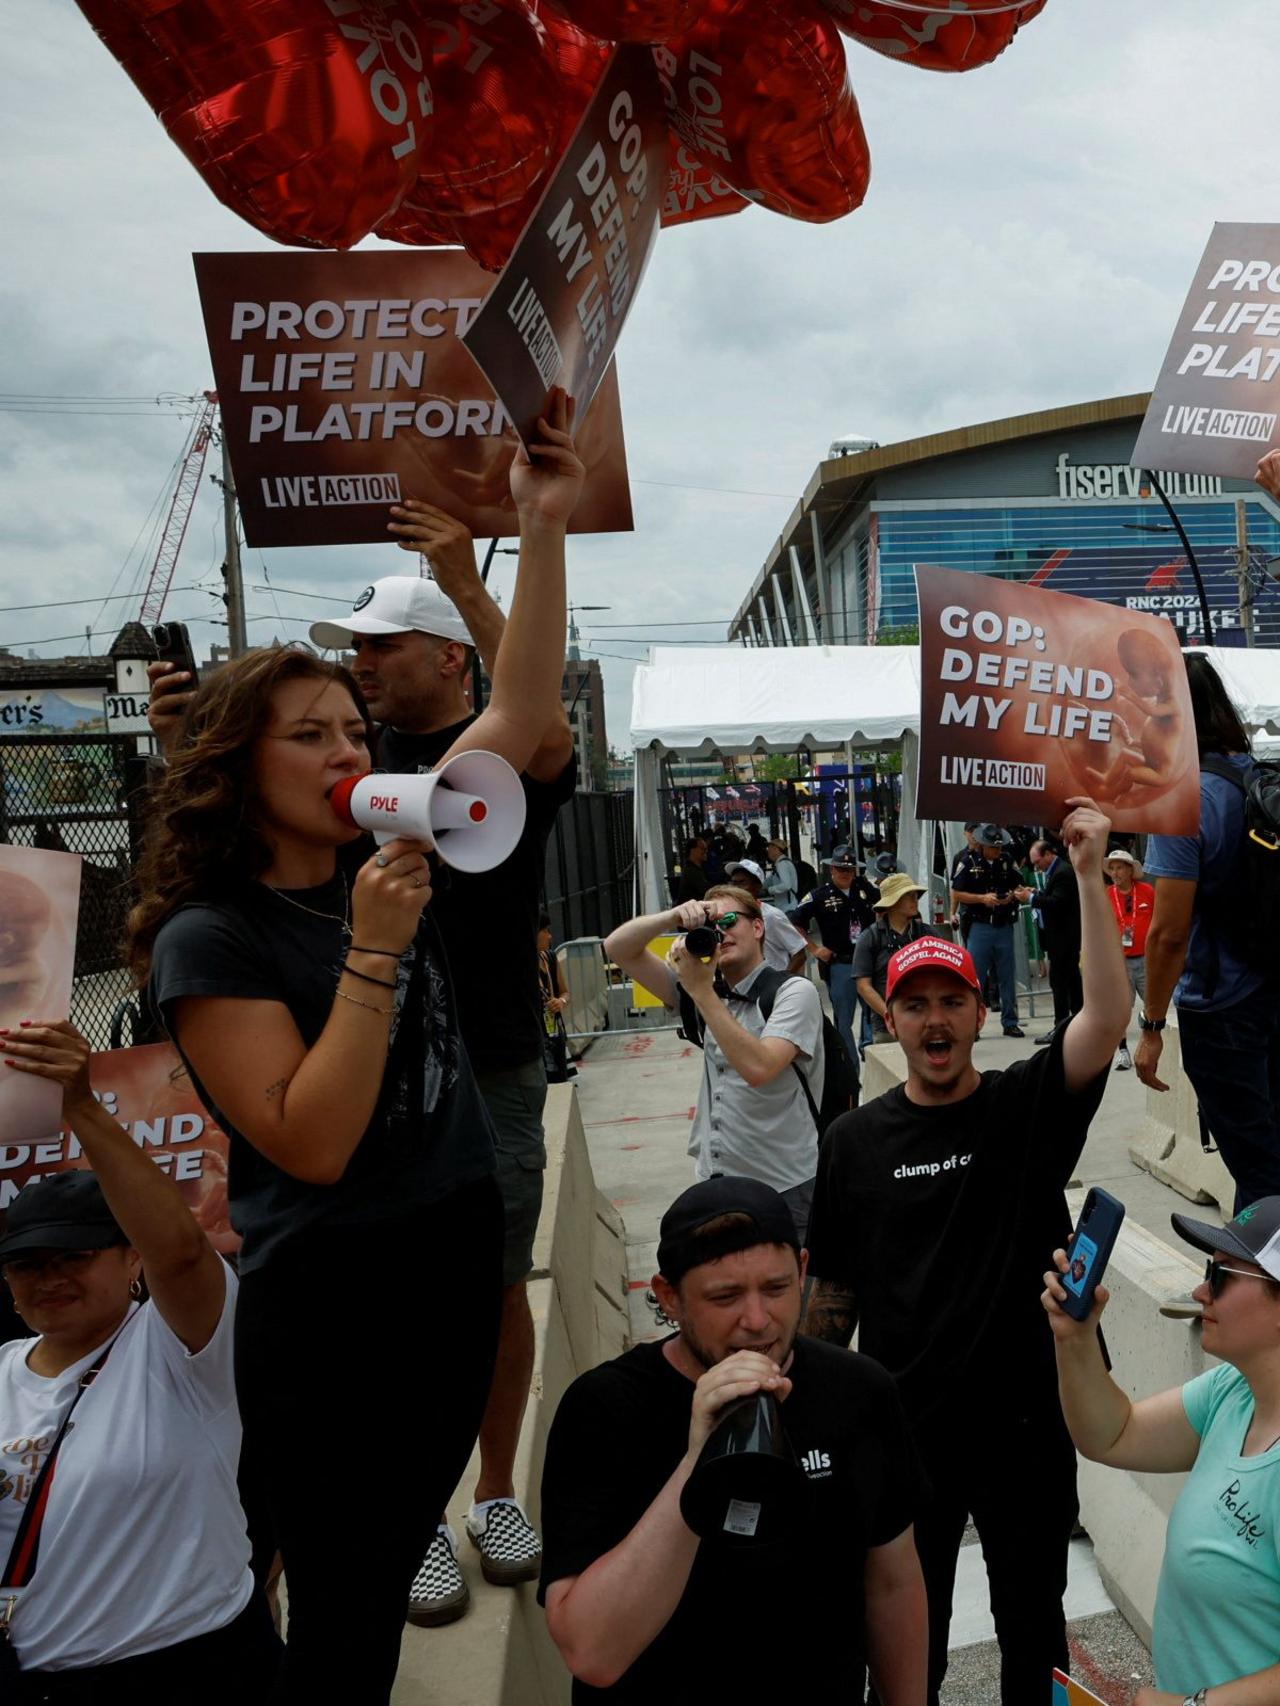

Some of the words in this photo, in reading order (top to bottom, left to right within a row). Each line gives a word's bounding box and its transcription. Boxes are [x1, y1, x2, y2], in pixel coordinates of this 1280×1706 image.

[608, 90, 648, 219] GOP:
[577, 142, 630, 318] DEFEND
[547, 197, 593, 283] MY
[577, 272, 607, 368] LIFE
[230, 298, 482, 341] PROTECT
[507, 277, 545, 346] LIVE
[240, 352, 356, 392] LIFE
[369, 350, 425, 389] IN
[1161, 404, 1209, 436] LIVE
[1206, 409, 1275, 441] ACTION
[261, 475, 319, 508] LIVE
[321, 474, 400, 504] ACTION
[1126, 596, 1160, 609] RNC
[1162, 595, 1201, 609] 2024
[940, 606, 1045, 651] GOP:
[940, 648, 1114, 700] DEFEND
[108, 696, 150, 719] Ma
[939, 692, 1013, 730] MY
[1024, 702, 1114, 742] LIFE
[940, 756, 984, 786] LIVE
[986, 760, 1044, 790] ACTION
[370, 796, 398, 813] PYLE
[896, 942, 921, 963] MAKE
[922, 940, 964, 960] AMERICA
[898, 951, 932, 971] GOSPEL
[933, 951, 962, 967] AGAIN
[0, 1113, 205, 1170] DEND
[893, 1162, 941, 1179] clump
[943, 1155, 957, 1170] of
[0, 1172, 57, 1209] M
[801, 1449, 831, 1472] ells
